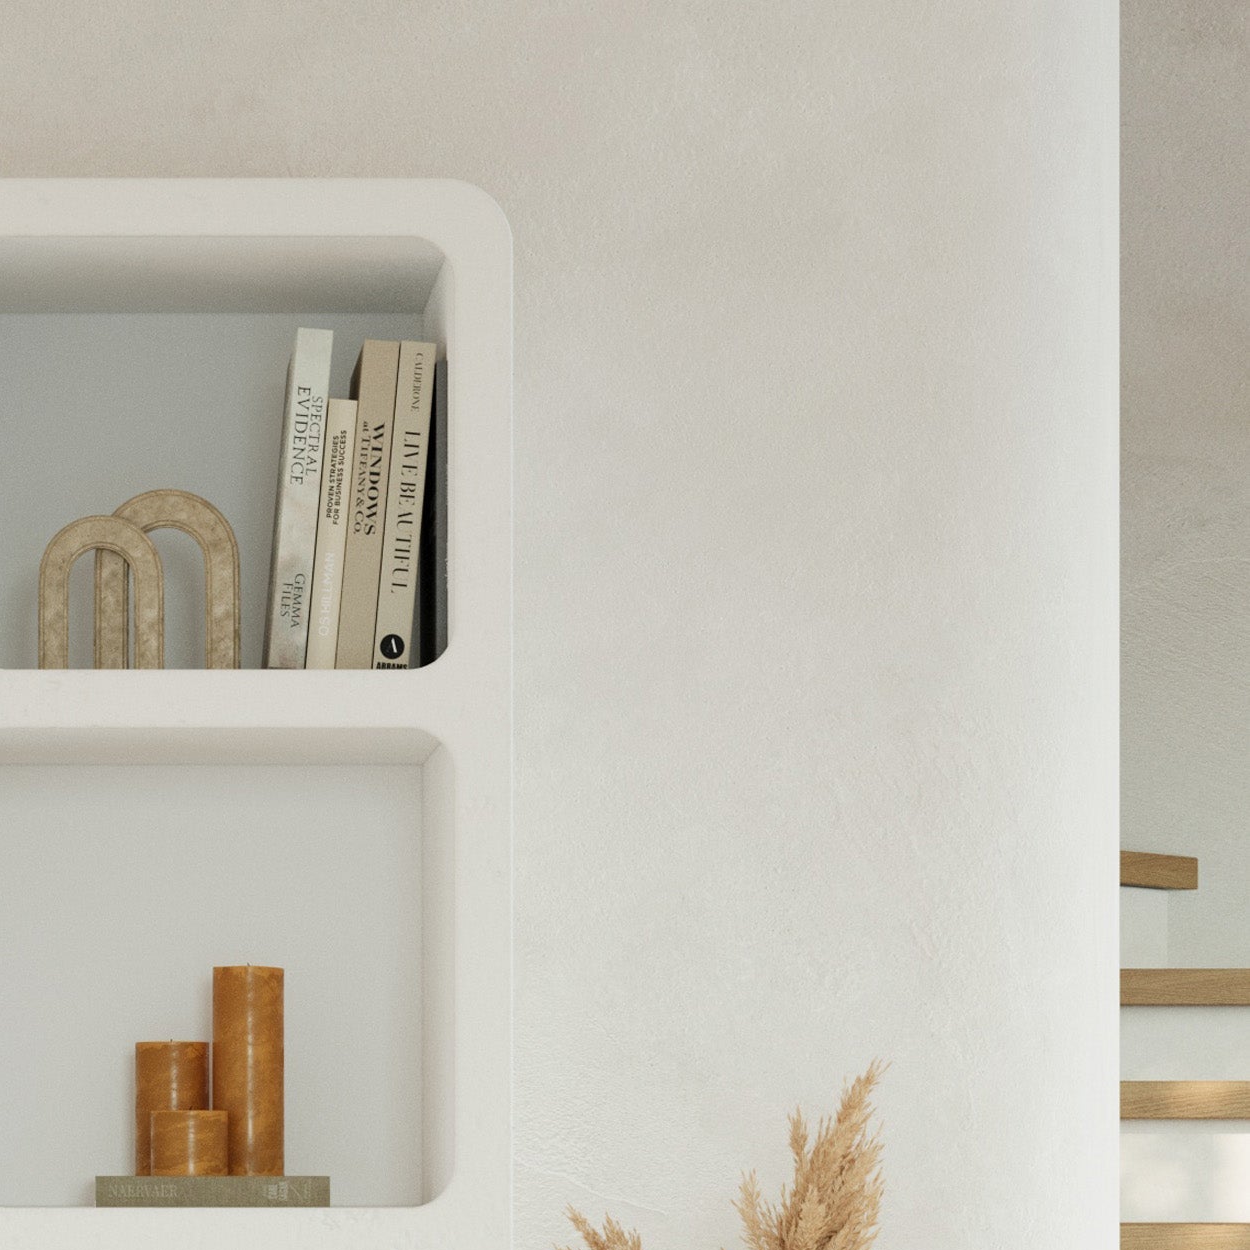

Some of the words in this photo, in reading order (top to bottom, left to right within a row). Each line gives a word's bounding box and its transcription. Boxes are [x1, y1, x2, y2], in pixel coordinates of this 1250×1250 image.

[410, 352, 424, 413] CALDERONE
[290, 385, 311, 486] EVIDENCE
[305, 396, 323, 476] SPECTRAL
[338, 429, 347, 466] SUCCESS
[363, 420, 371, 432] at
[328, 435, 339, 484] STRATEGIES
[356, 435, 370, 494] TIFFANY
[401, 431, 421, 476] LIVE
[326, 484, 335, 518] PROVEN
[335, 468, 344, 506] BUSINESS
[355, 497, 365, 507] &
[364, 421, 385, 536] WINDOWS
[391, 482, 416, 594] BEAUTIFUL
[280, 582, 293, 618] FILES
[290, 572, 306, 629] GEMMA
[321, 552, 335, 615] HILLMAN
[318, 617, 330, 636] OS
[375, 661, 408, 670] ABRAMS
